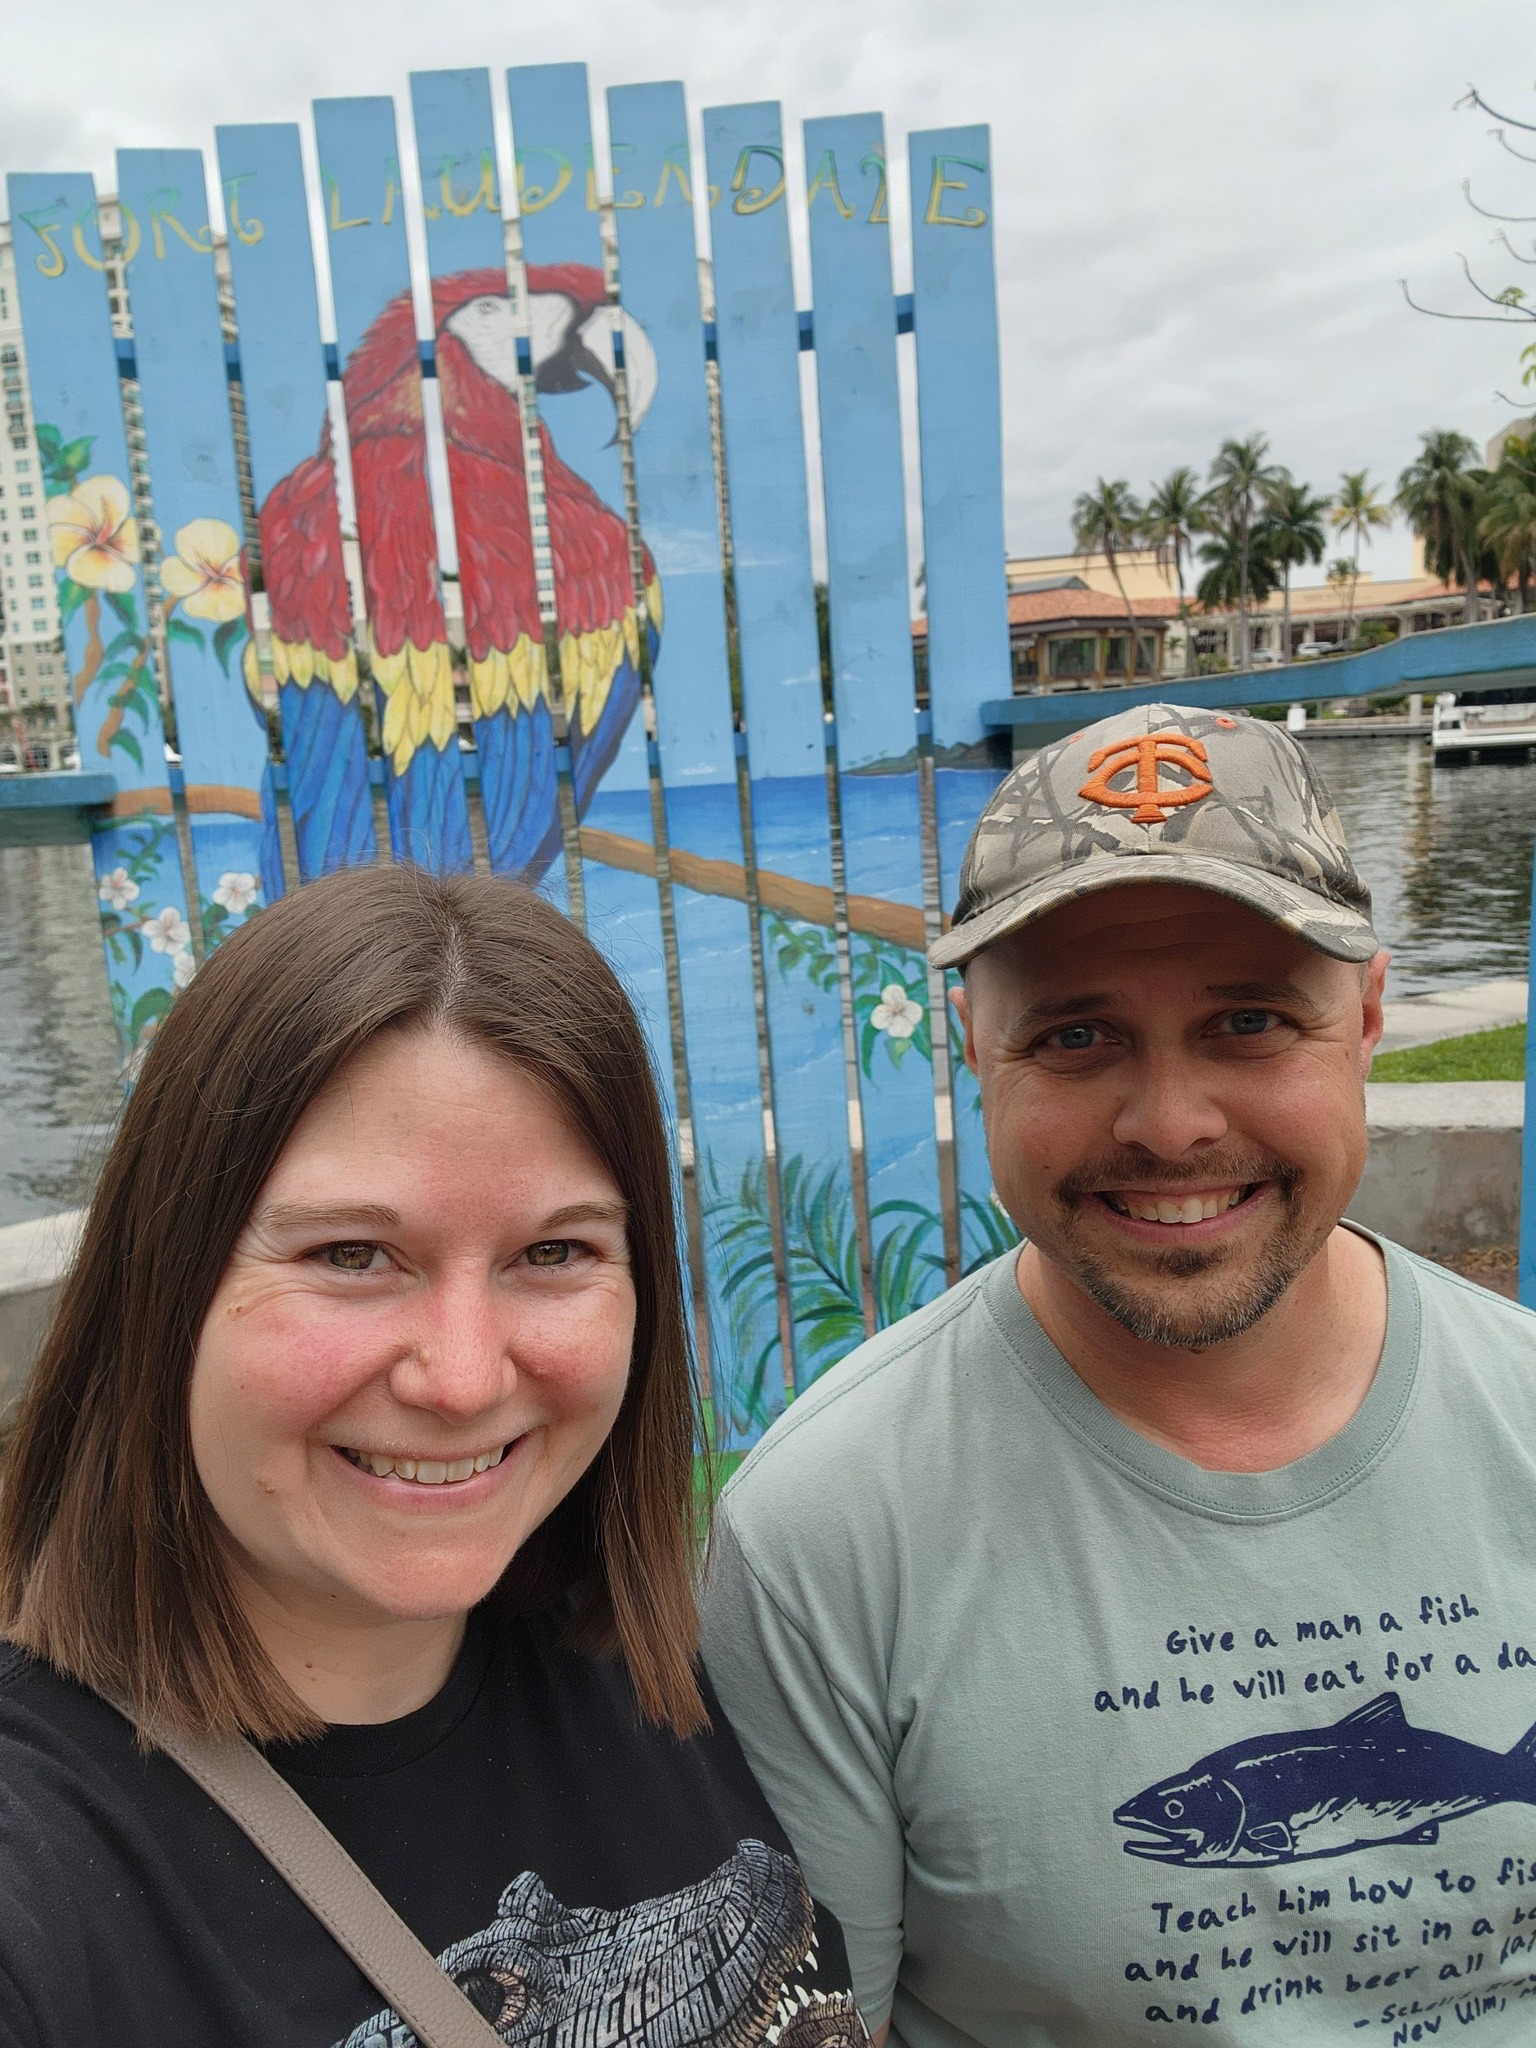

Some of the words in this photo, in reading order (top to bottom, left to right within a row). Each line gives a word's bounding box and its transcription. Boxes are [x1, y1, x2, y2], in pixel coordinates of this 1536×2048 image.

[18, 172, 265, 278] FORT
[1166, 1625, 1235, 1655] Give
[1254, 1627, 1278, 1649] a
[1296, 1612, 1362, 1642] man
[1379, 1611, 1403, 1633] a
[1418, 1593, 1479, 1626] fish
[1094, 1680, 1160, 1713] and
[1179, 1677, 1215, 1705] he
[1232, 1669, 1286, 1700] will
[1304, 1660, 1365, 1692] eat
[1385, 1651, 1434, 1681] for
[1455, 1652, 1481, 1675] a
[1151, 1892, 1257, 1934] Teach
[1277, 1886, 1332, 1916] him
[1348, 1875, 1414, 1904] how
[1434, 1869, 1477, 1893] to
[1124, 1954, 1200, 1983] and
[1220, 1947, 1253, 1971] he
[1272, 1930, 1332, 1956] will
[1352, 1924, 1401, 1953] sit
[1421, 1918, 1452, 1946] in
[1471, 1917, 1495, 1937] a
[1144, 1997, 1221, 2026] and
[1240, 1973, 1325, 2016] drink
[1345, 1963, 1421, 1993] beer
[1438, 1952, 1485, 1981] all
[1392, 2014, 1443, 2048] New
[1454, 1994, 1507, 2026] Ulm,
